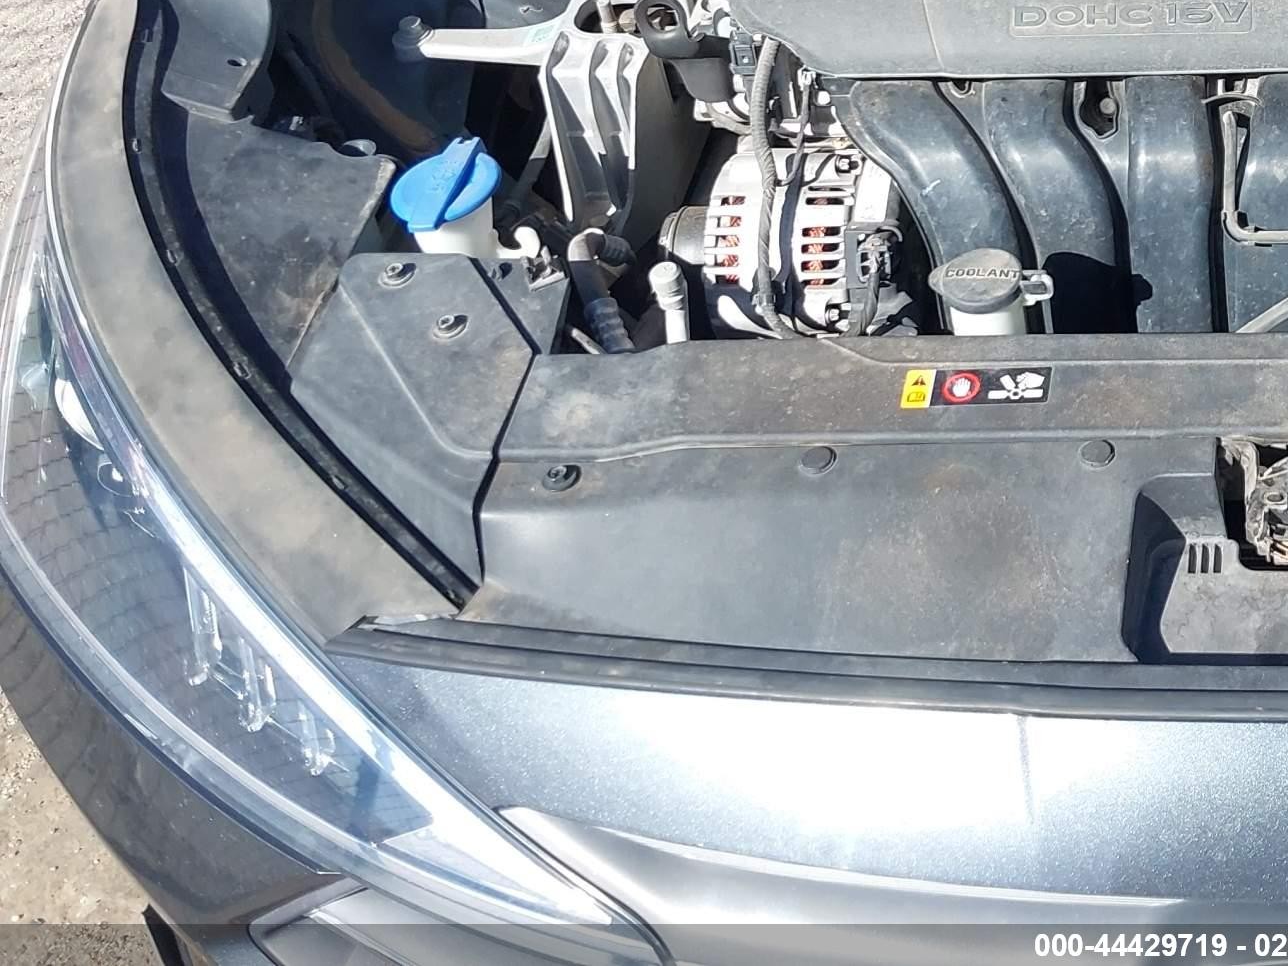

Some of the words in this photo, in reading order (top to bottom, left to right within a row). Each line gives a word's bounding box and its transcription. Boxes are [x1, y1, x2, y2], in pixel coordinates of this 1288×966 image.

[1012, 2, 1153, 27] DOHC
[1165, 1, 1248, 25] 16V
[944, 266, 1021, 280] COOLANT
